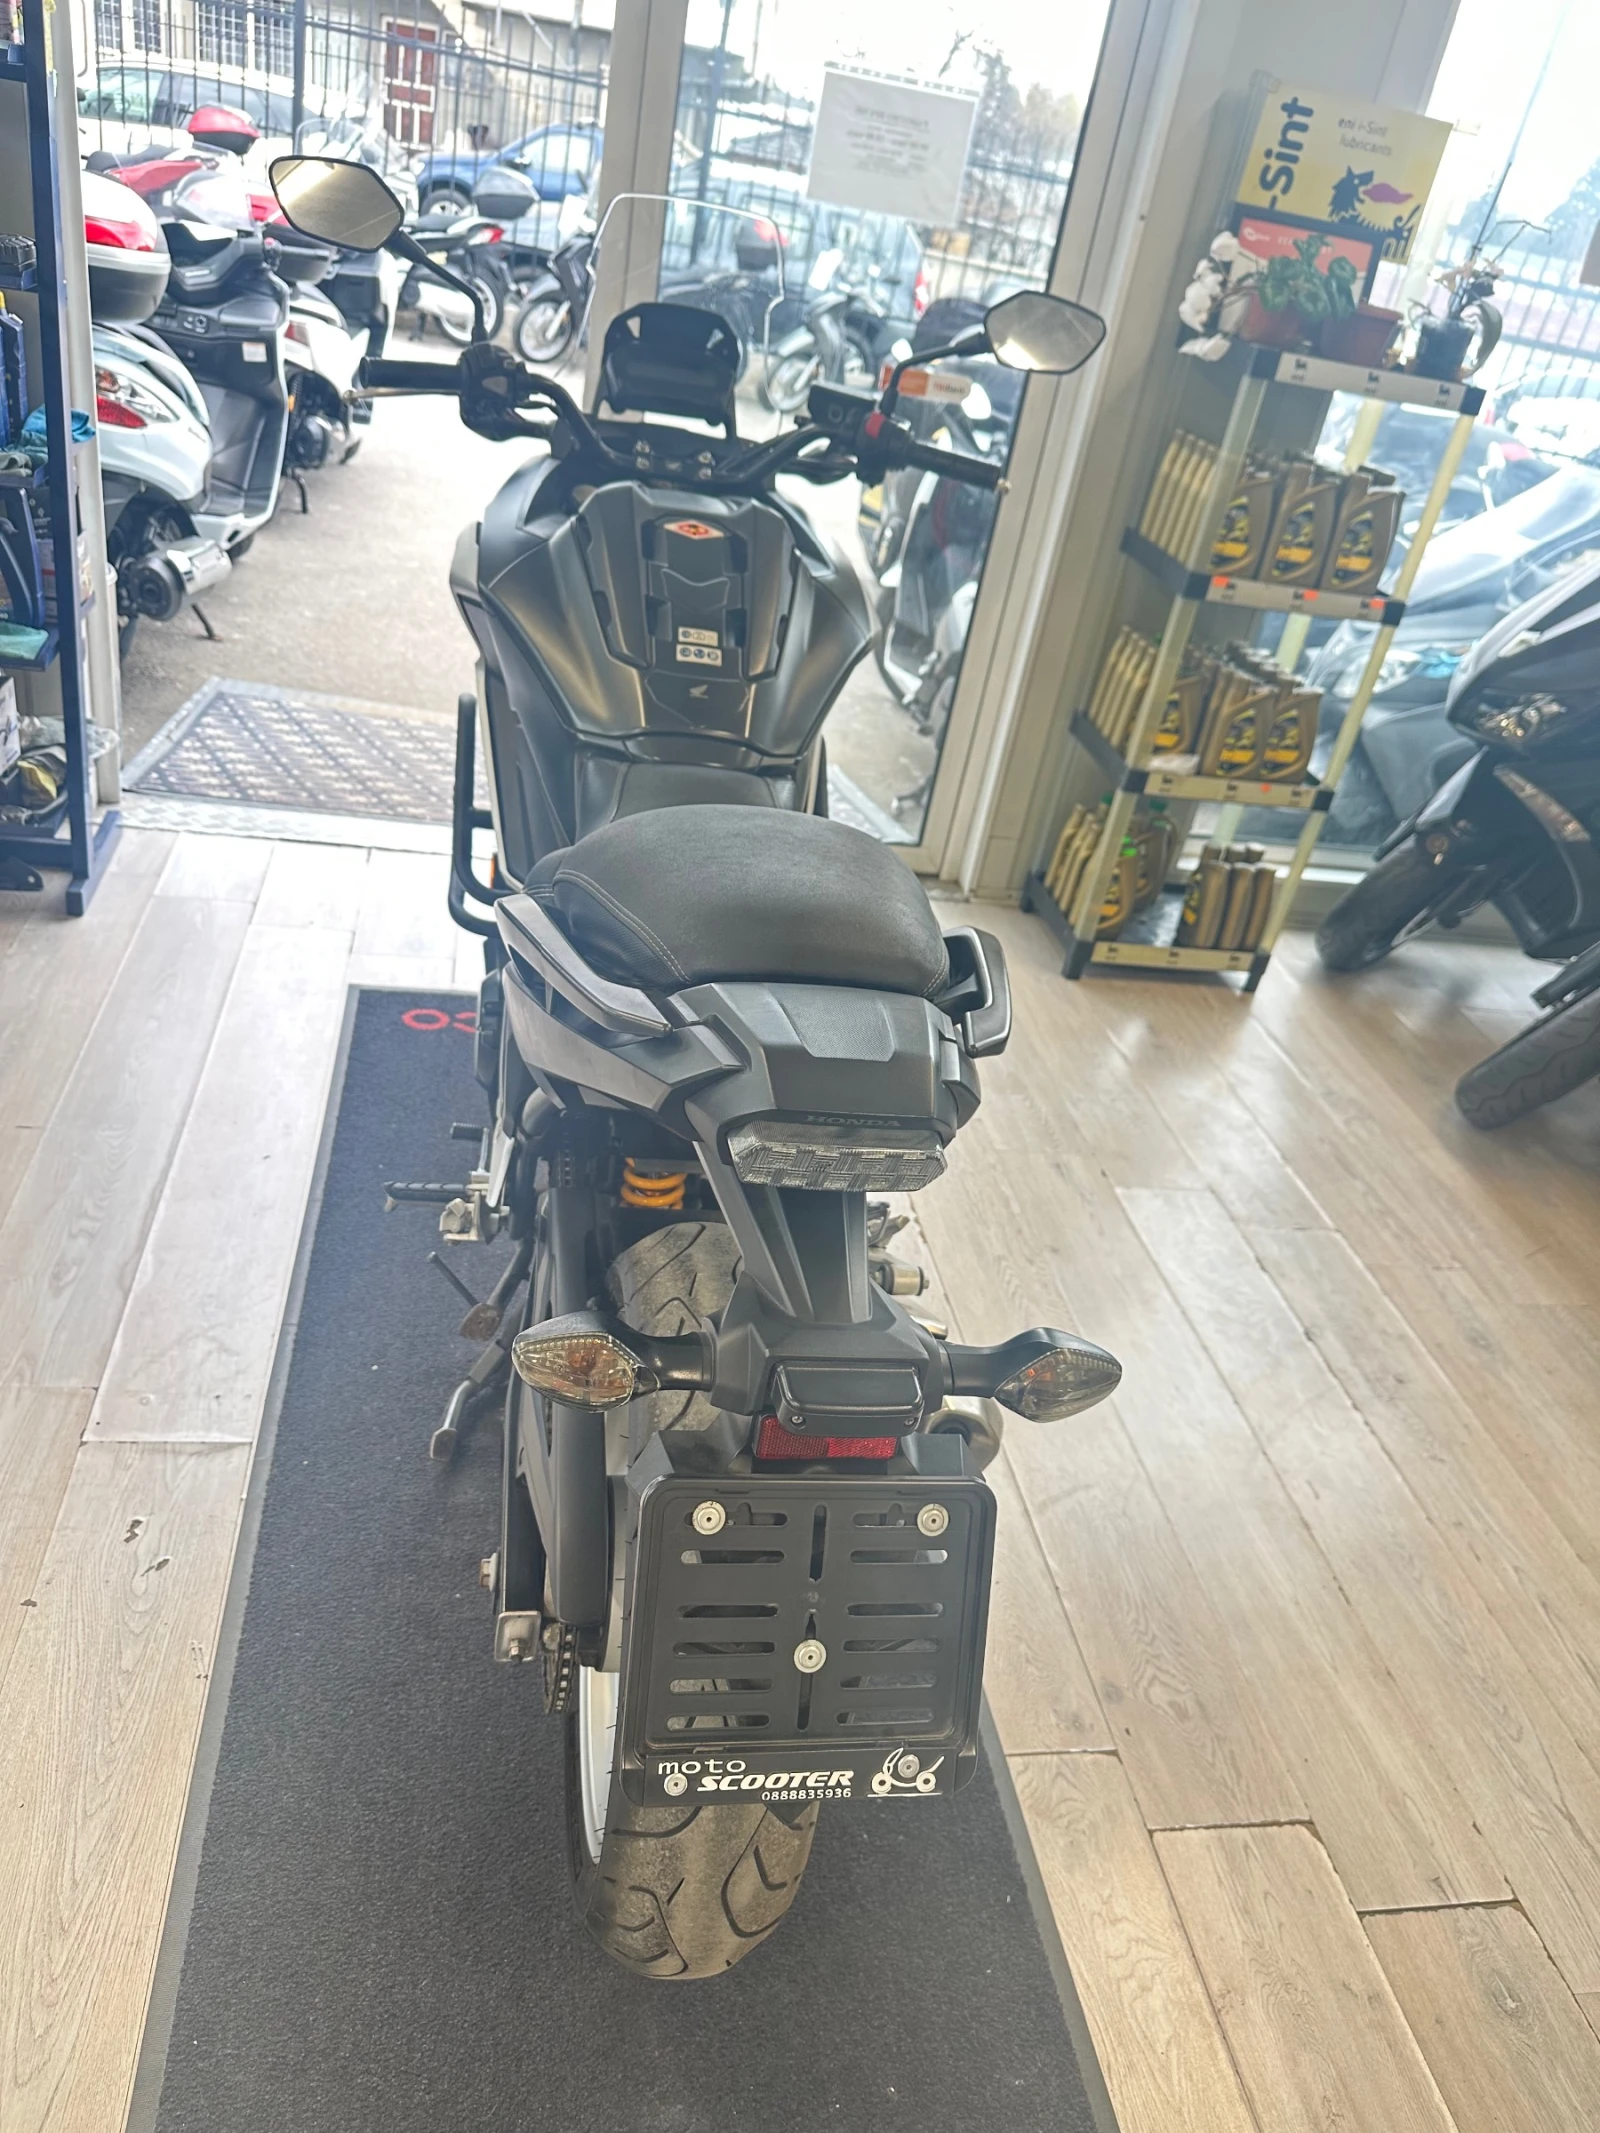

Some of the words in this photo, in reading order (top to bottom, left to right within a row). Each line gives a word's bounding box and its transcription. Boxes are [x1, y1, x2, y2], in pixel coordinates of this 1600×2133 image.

[1259, 97, 1314, 211] -Sint
[1339, 135, 1392, 157] lubricants
[1380, 230, 1410, 259] ni
[806, 1115, 902, 1127] HONDA
[658, 1758, 747, 1775] moto
[697, 1770, 855, 1792] SCOOTER
[761, 1787, 852, 1801] 0888835936
